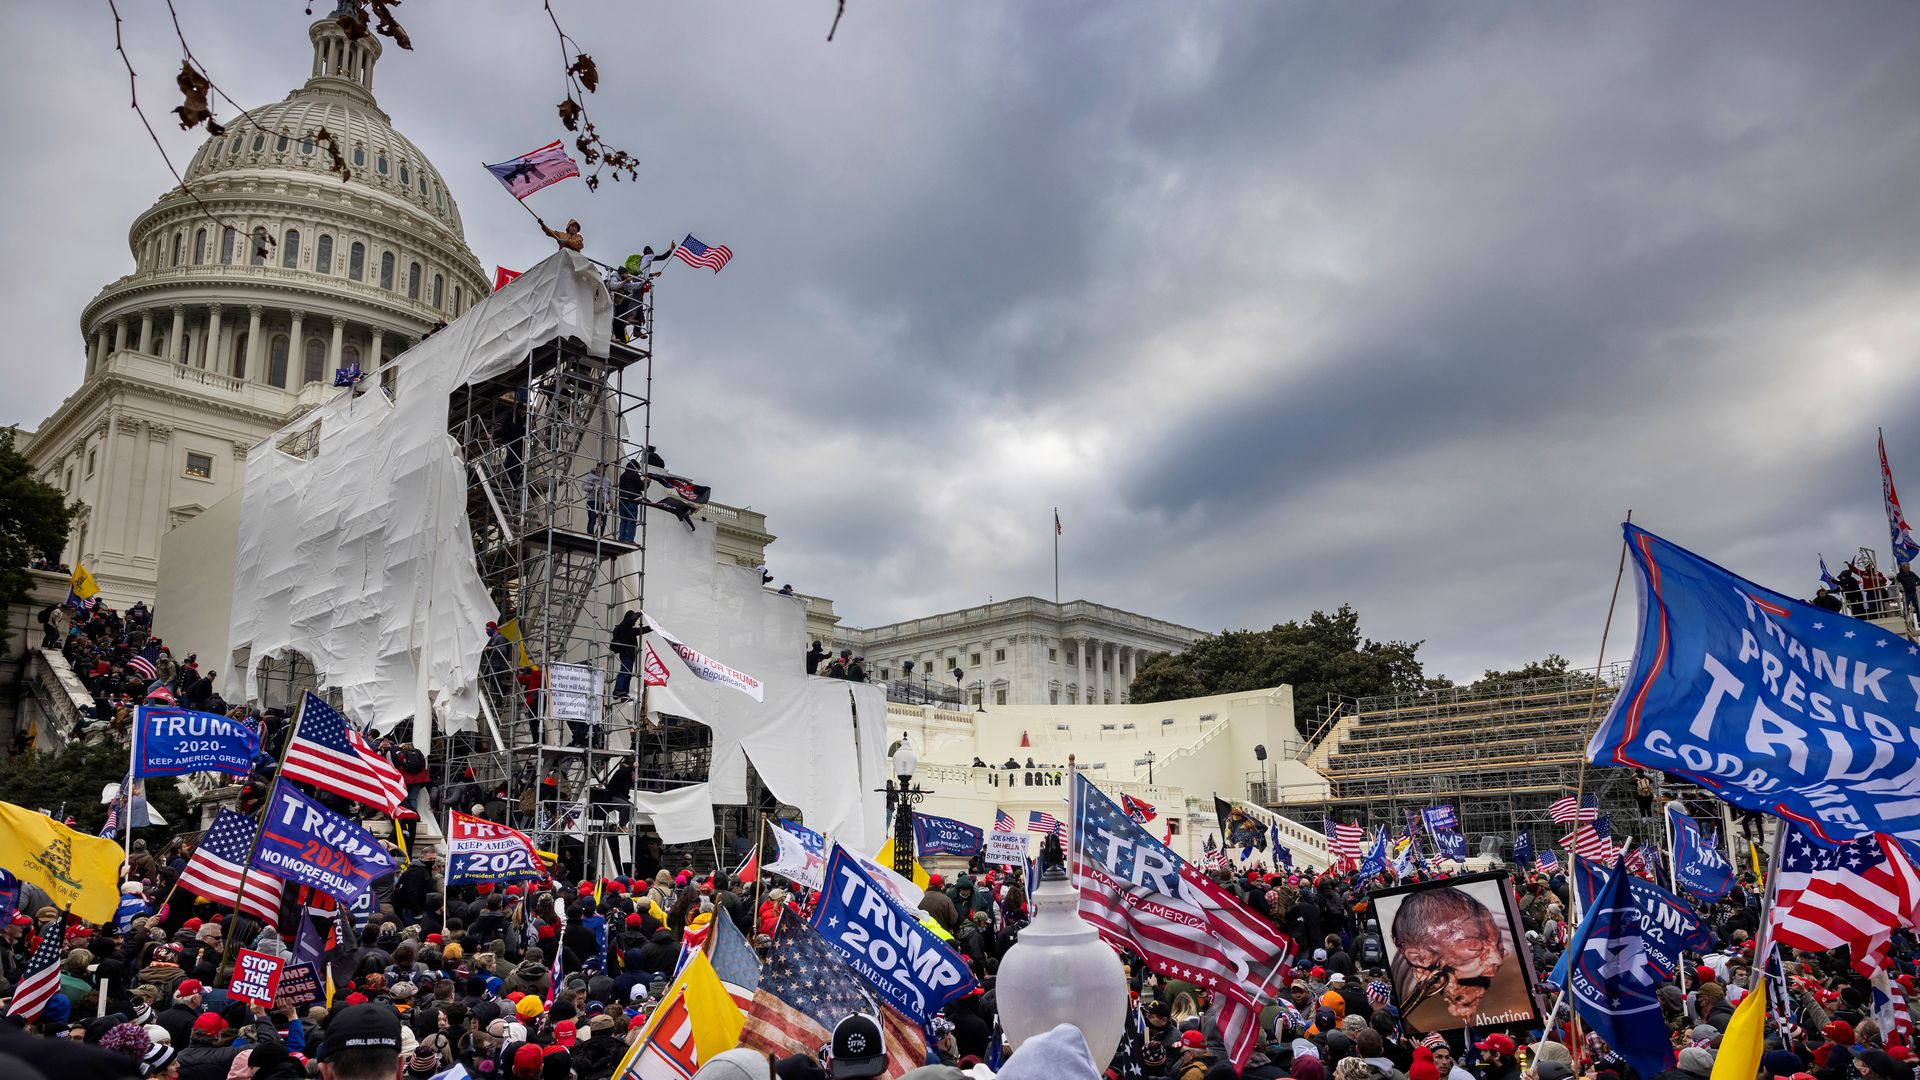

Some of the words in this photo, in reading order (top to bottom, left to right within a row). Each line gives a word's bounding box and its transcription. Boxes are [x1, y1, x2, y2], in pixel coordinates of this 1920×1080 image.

[703, 666, 747, 692] Republicans
[704, 657, 725, 672] FOR
[727, 668, 759, 689] TRUMP
[149, 757, 173, 765] KEEP
[175, 754, 217, 765] AMERICA
[218, 754, 248, 767] GREAT!
[1644, 729, 1744, 778] GOD
[282, 793, 393, 866] TRUMP
[991, 834, 1001, 842] JOE
[301, 839, 352, 877] 2020
[457, 841, 482, 850] KEEP
[1002, 854, 1012, 862] THE
[24, 860, 43, 872] DONT
[58, 885, 68, 895] ON
[69, 890, 79, 901] ME
[261, 848, 284, 864] NO
[281, 855, 322, 879] MORE
[320, 873, 358, 895] BULLT
[1091, 870, 1138, 906] MAKING
[1141, 903, 1207, 933] AMERICA
[333, 918, 344, 945] FOR
[840, 865, 962, 991] TRUMP
[241, 954, 278, 972] STOP
[231, 980, 272, 1002] STEAL
[244, 969, 270, 987] THE
[277, 981, 317, 996] MORE
[850, 958, 908, 1006] AMERICA
[1572, 967, 1604, 1001] FIRST
[1475, 1009, 1530, 1027] Abortion
